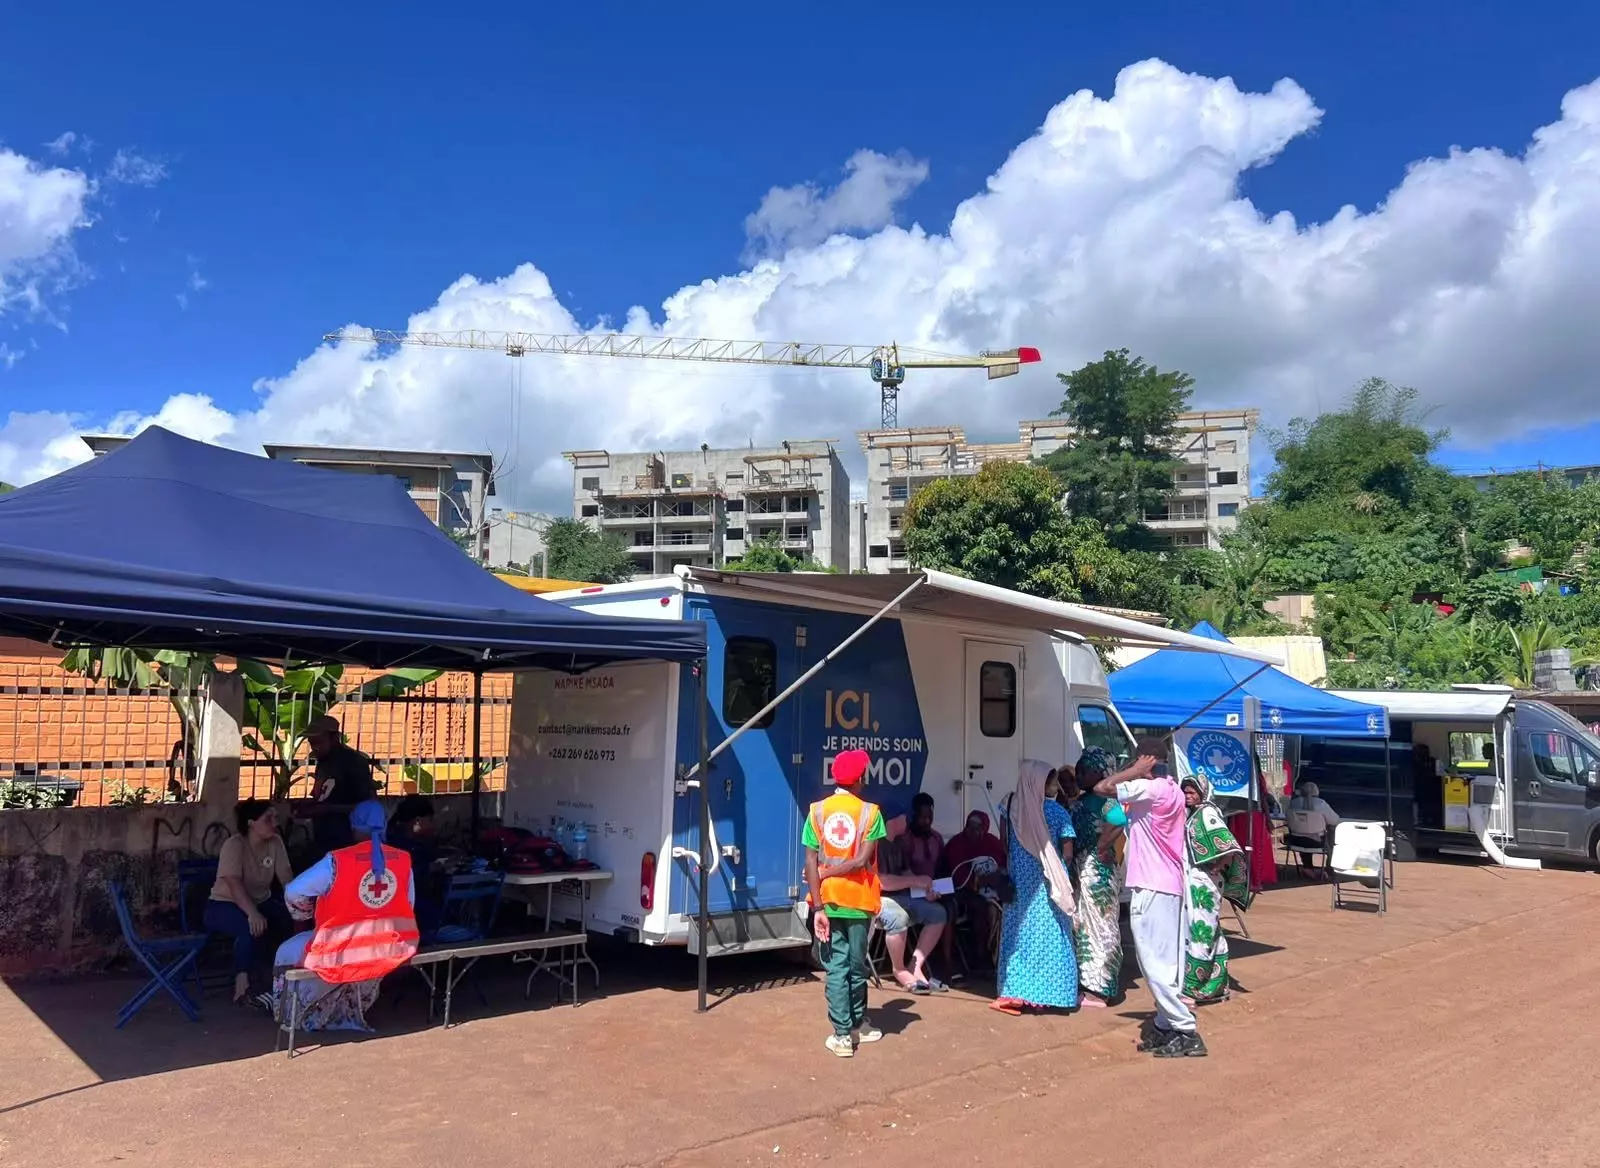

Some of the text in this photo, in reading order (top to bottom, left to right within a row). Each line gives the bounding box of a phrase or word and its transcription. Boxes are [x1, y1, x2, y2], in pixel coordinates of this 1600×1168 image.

[585, 676, 615, 689] MSADA
[824, 689, 880, 733] ICI,
[538, 724, 631, 736] contact@narikemsada.fr
[822, 736, 922, 752] JE PRENDS SOIN
[567, 748, 583, 760] 269
[583, 749, 599, 760] 626
[600, 750, 615, 761] 973
[865, 757, 911, 785] MOI
[1211, 768, 1246, 787] MONDE
